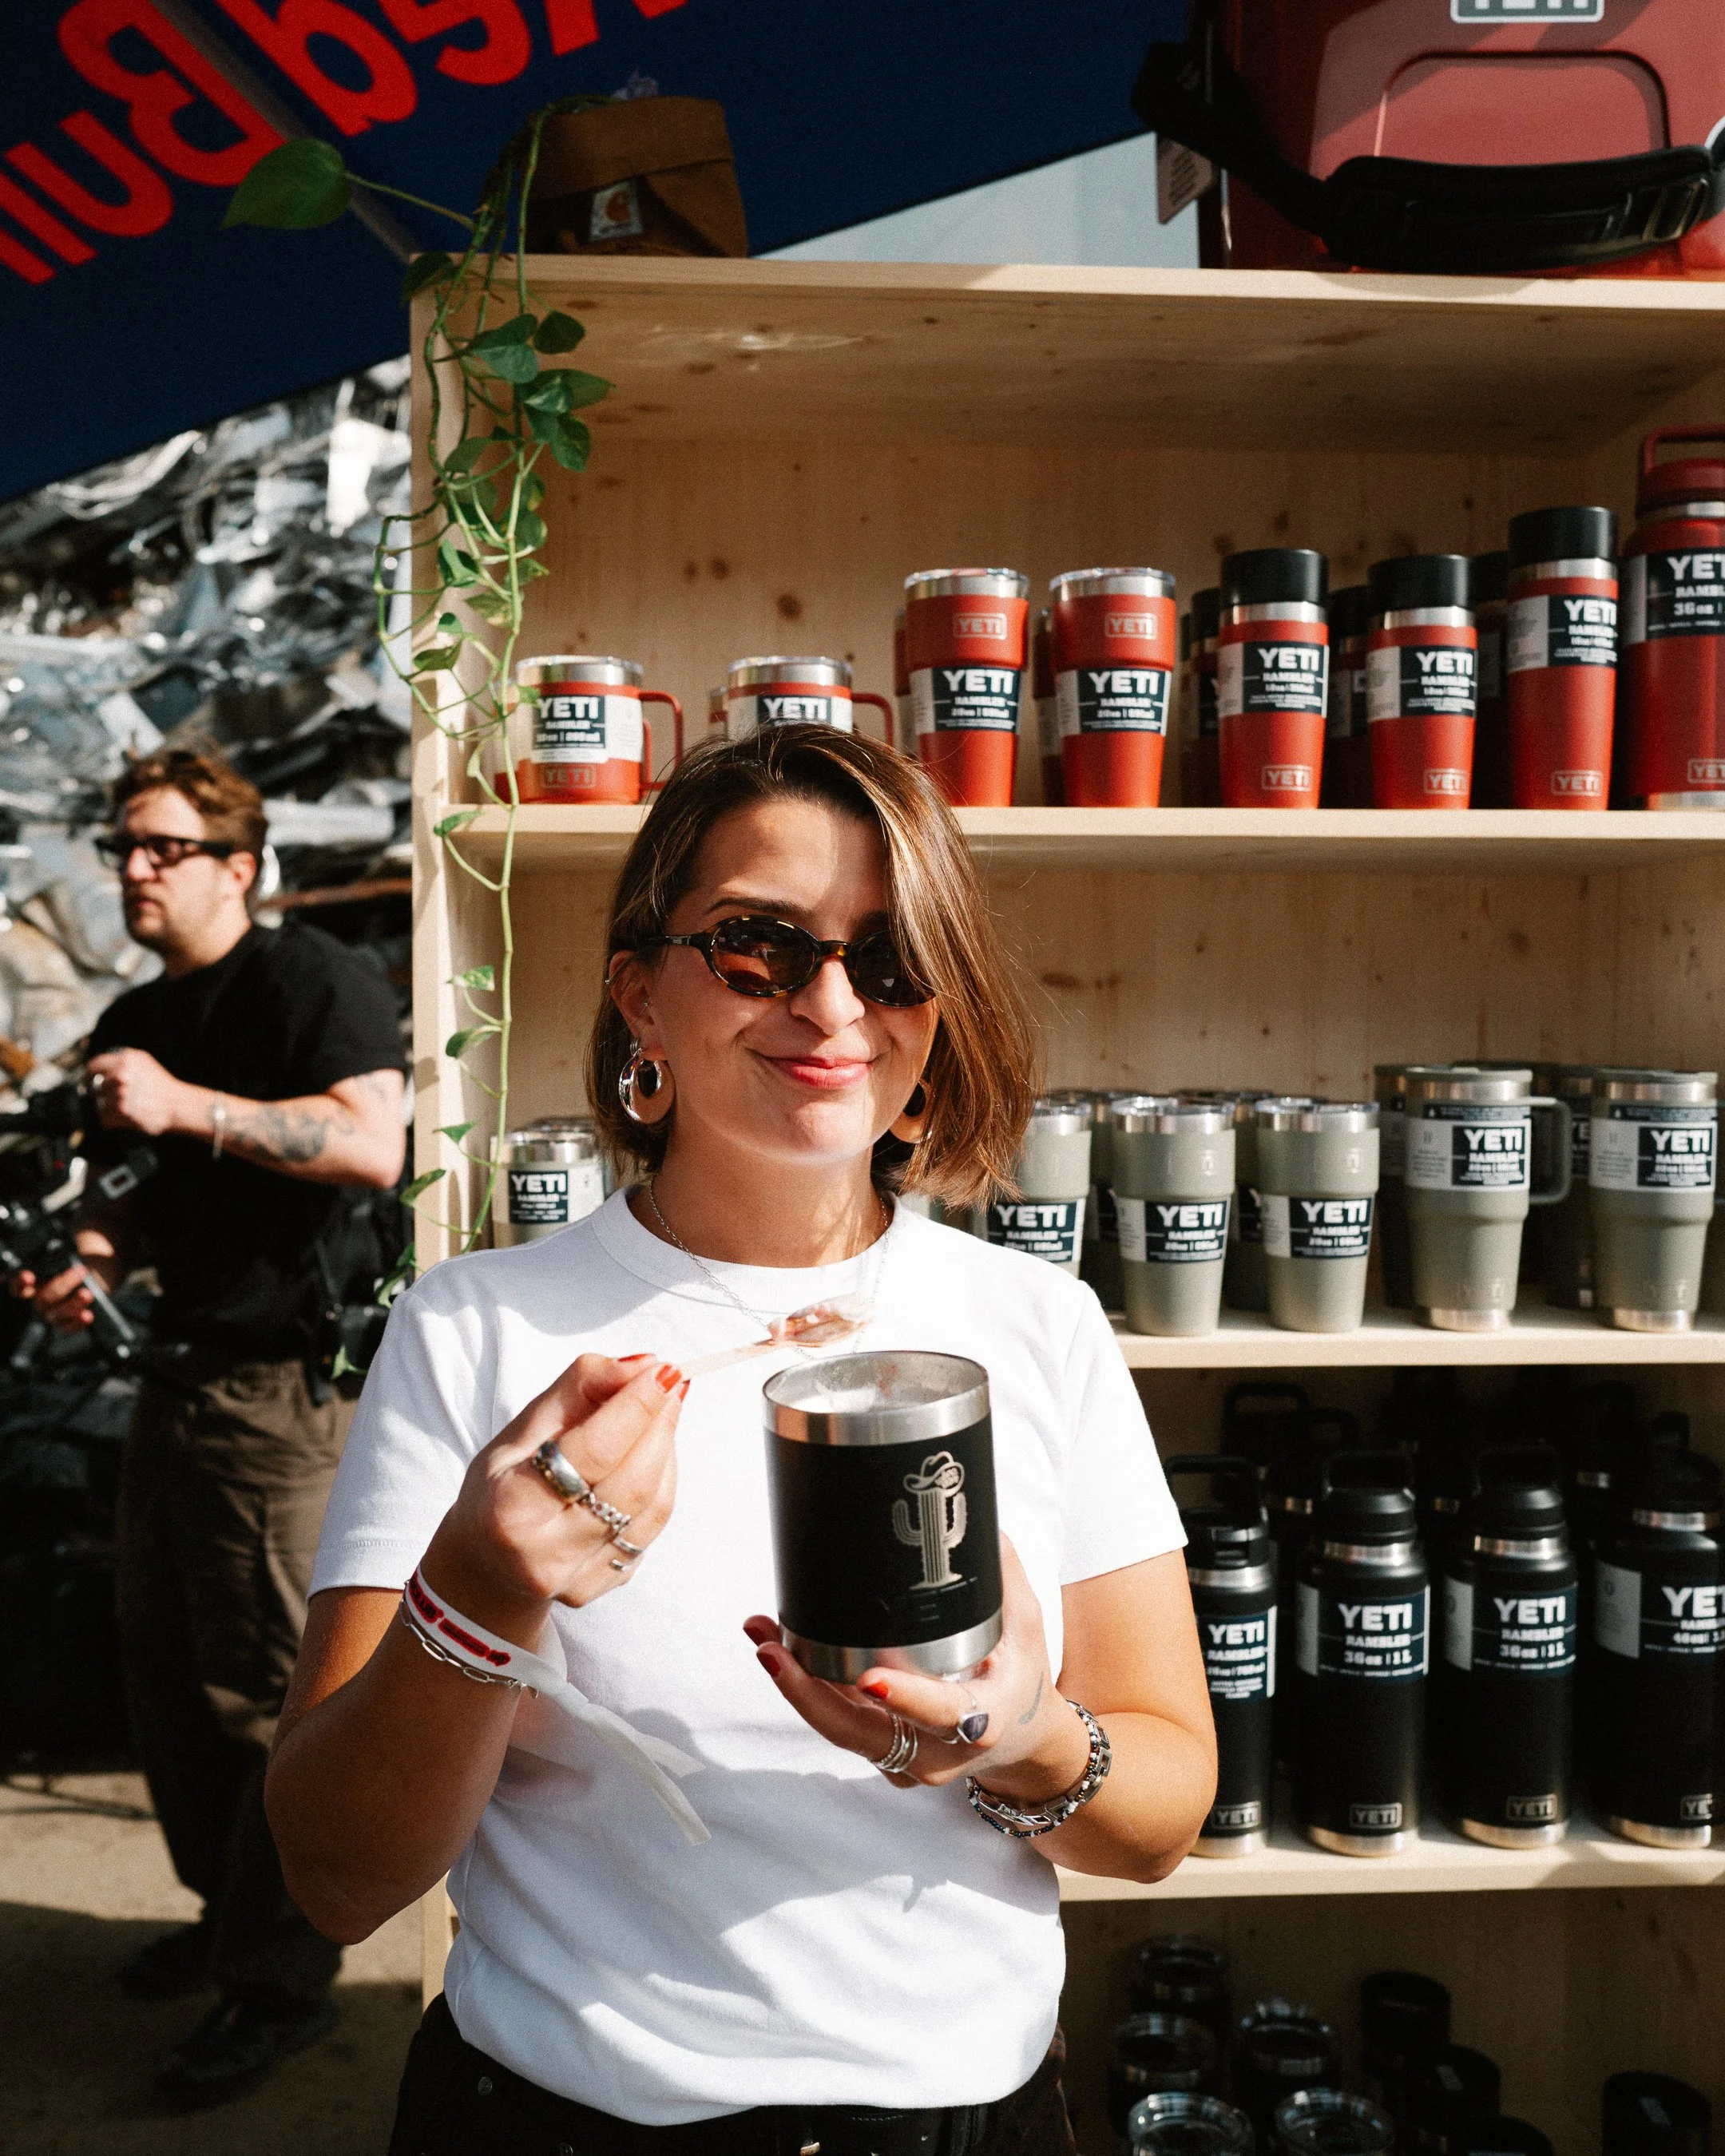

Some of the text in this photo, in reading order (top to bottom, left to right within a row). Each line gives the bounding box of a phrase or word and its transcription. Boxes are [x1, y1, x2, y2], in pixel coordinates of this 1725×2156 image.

[1667, 553, 1725, 581] YE
[1564, 599, 1616, 626] YETI
[959, 619, 1001, 633] YETI
[1111, 619, 1153, 633] YETI
[1258, 647, 1319, 672] YETI
[1416, 651, 1473, 676] YETI
[942, 669, 1014, 694] YETI
[1089, 671, 1160, 696] YETI
[536, 696, 599, 719] YETI
[763, 698, 828, 719] YETI
[1267, 770, 1311, 787] YETI
[1557, 775, 1602, 792] YETI
[1464, 1128, 1523, 1151] YETI
[1650, 1130, 1711, 1152] YETI
[510, 1173, 567, 1193] YETI
[997, 1204, 1069, 1228] YETI
[1156, 1203, 1223, 1228] YETI
[1300, 1200, 1368, 1223] YETI
[1493, 1595, 1566, 1624] YETI
[1661, 1585, 1725, 1618] YE
[1338, 1603, 1413, 1631] YETI
[1208, 1620, 1265, 1645] YETI
[1216, 1808, 1258, 1825] YETI
[1356, 1809, 1397, 1825] YETI
[1513, 1799, 1552, 1815] YETI
[1686, 1800, 1710, 1815] YE
